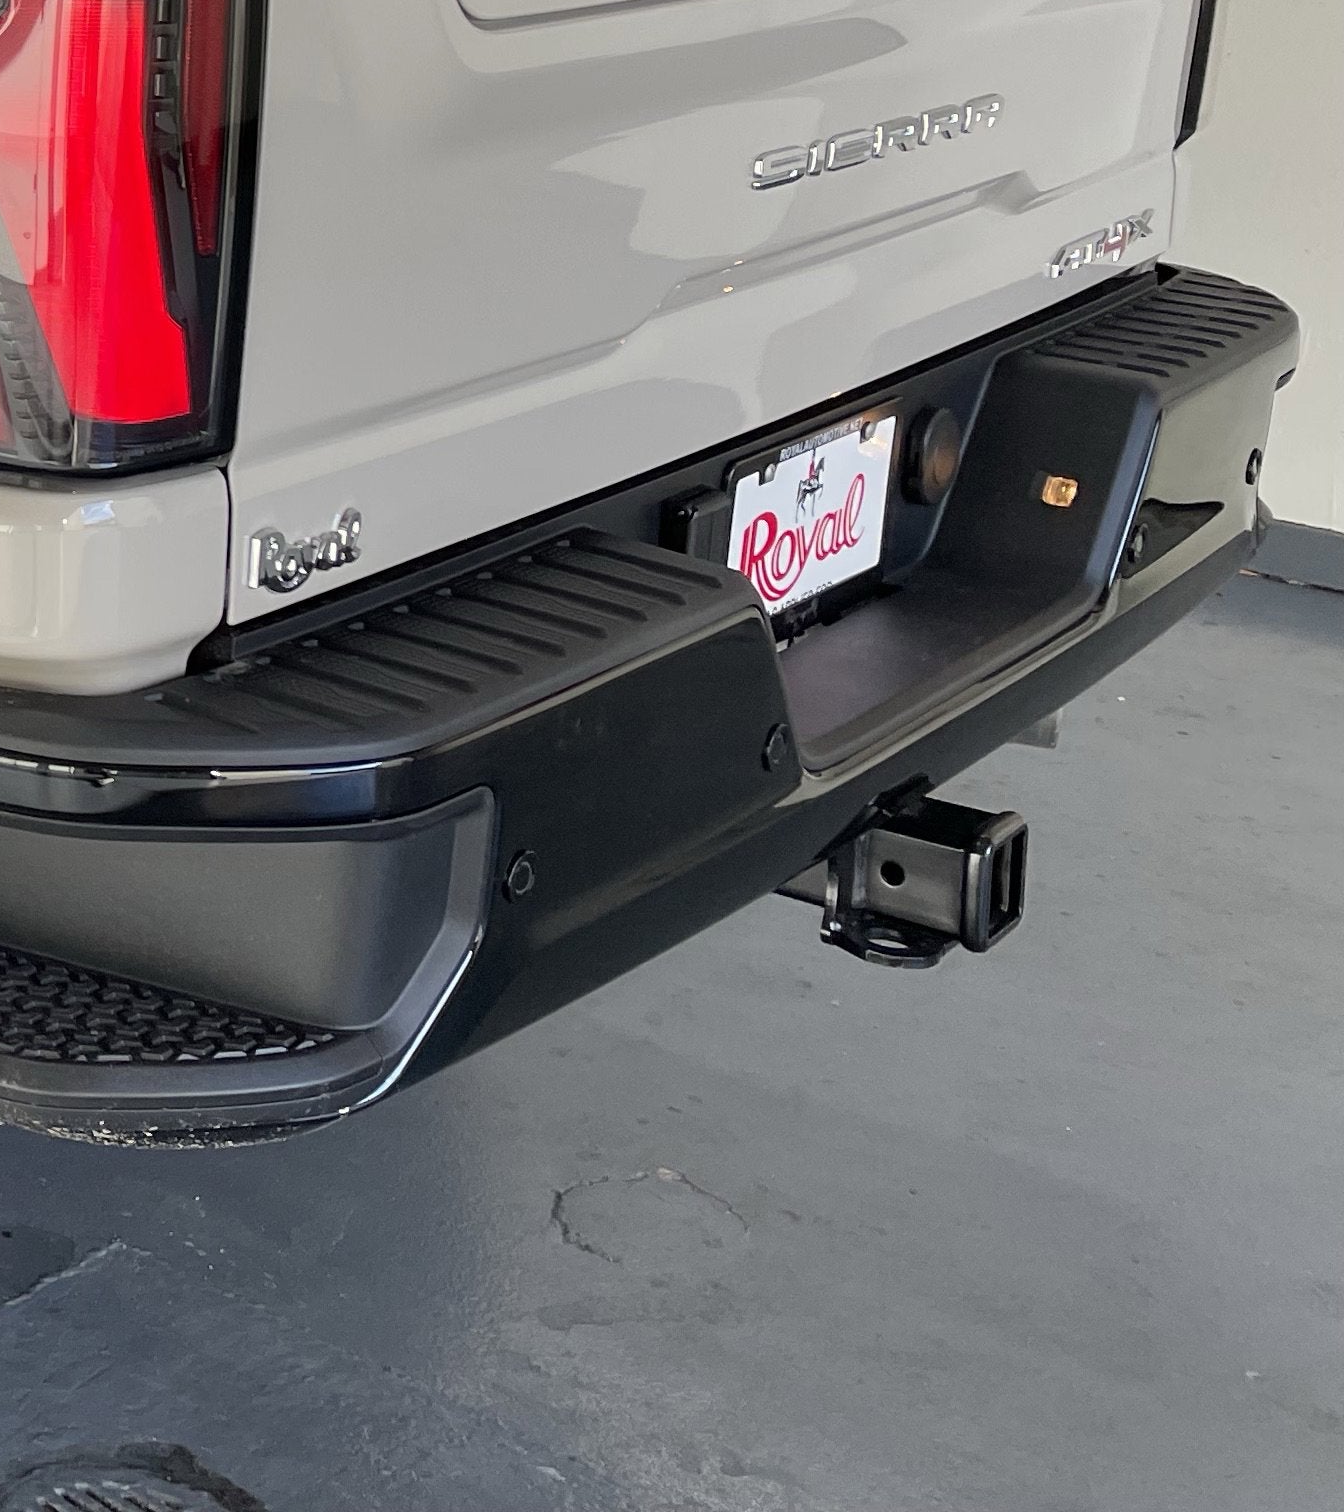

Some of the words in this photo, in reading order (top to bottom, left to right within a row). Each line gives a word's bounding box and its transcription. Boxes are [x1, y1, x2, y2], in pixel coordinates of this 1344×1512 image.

[751, 92, 1005, 190] SIERRA
[1048, 207, 1156, 279] AT4X
[247, 507, 362, 593] Royal
[739, 473, 865, 602] Royal
